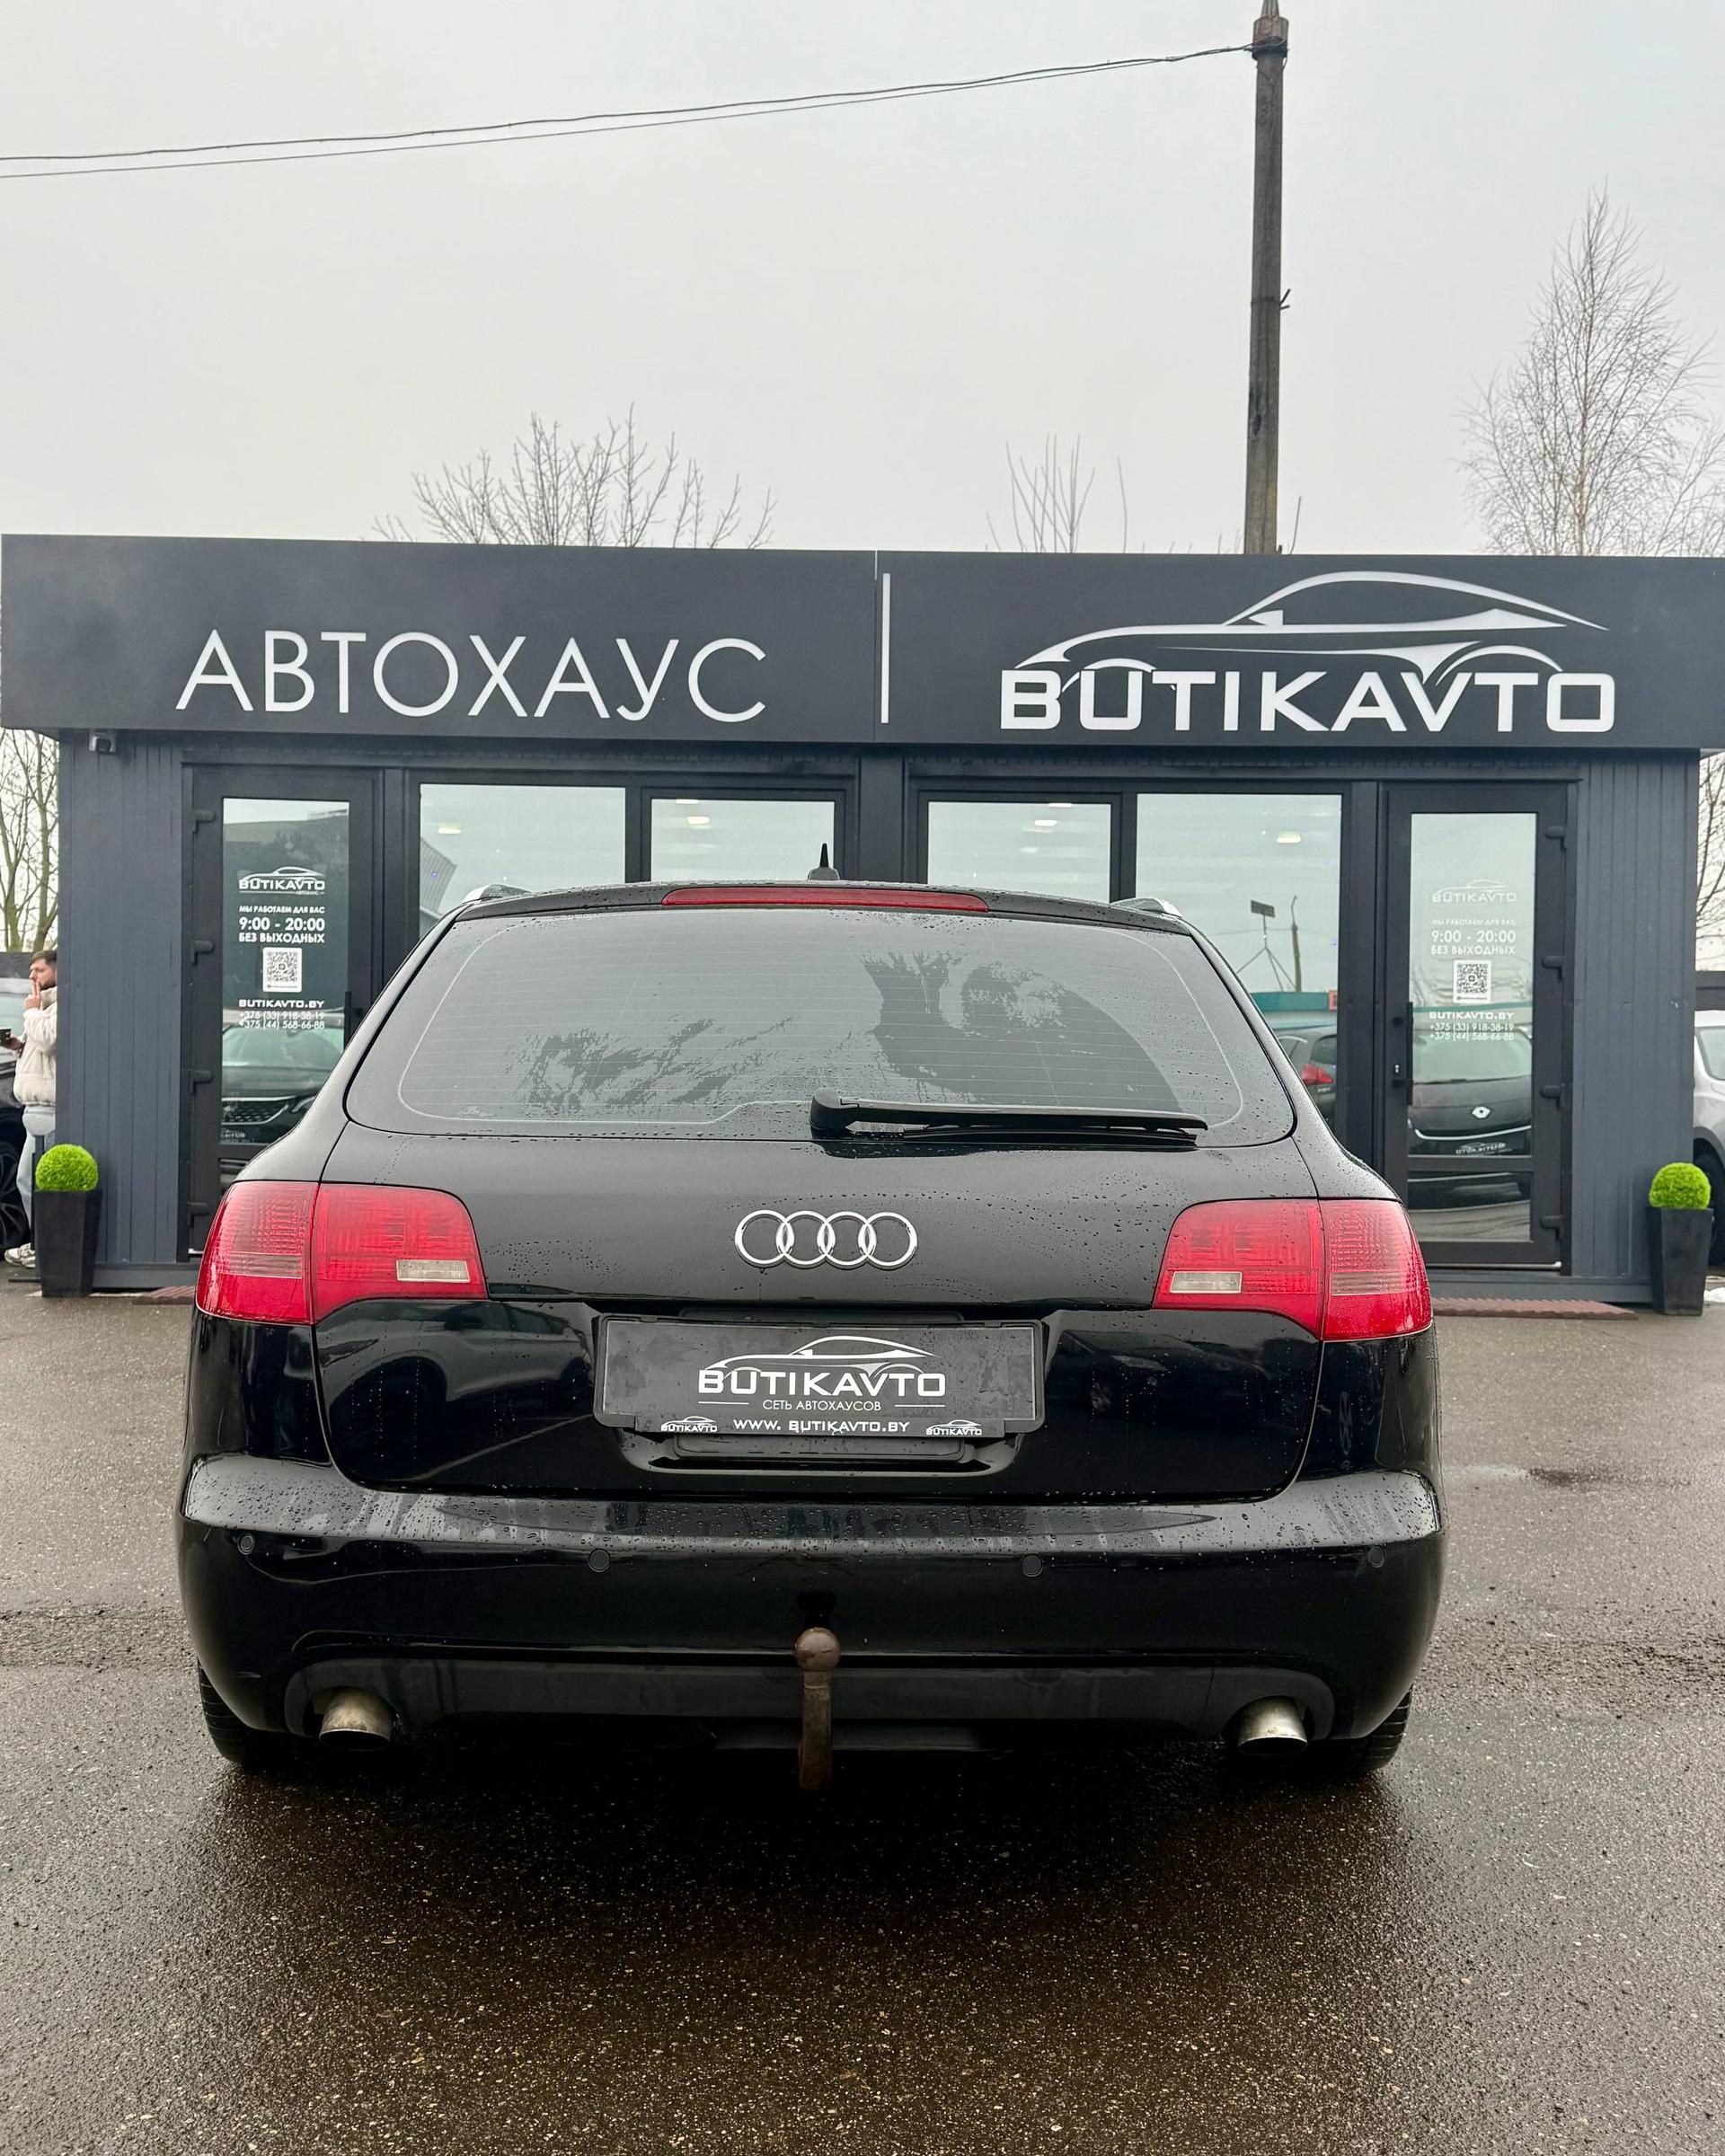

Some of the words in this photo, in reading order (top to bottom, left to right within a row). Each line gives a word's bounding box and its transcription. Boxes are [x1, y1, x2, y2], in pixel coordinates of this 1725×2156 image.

[175, 629, 766, 723] АВТОХАУС
[1000, 668, 1615, 733] BUTIKAVTO
[238, 879, 325, 890] BUTIKAVTO
[1431, 892, 1517, 903] BUTIKAVTO
[253, 906, 292, 914] РАБОТАЕМ
[292, 906, 309, 915] ДЛЯ
[239, 916, 270, 931] 9:00
[285, 917, 325, 932] 20:00
[238, 932, 257, 942] БЕЗ
[259, 932, 325, 944] ВЫХОДНЫХ
[1431, 930, 1462, 943] 9:00
[1476, 930, 1516, 943] 20:00
[1430, 944, 1448, 955] БЕЗ
[1451, 944, 1516, 956] ВЫХОДНЫХ
[238, 999, 325, 1009] BUTIKAVTO.BY
[239, 1011, 261, 1020] +375
[262, 1011, 280, 1021] (33)
[281, 1012, 325, 1021] 918-38-19
[1429, 1012, 1515, 1020] BUTIKAVTO.BY
[238, 1021, 261, 1029] +375
[262, 1020, 280, 1030] (44)
[281, 1021, 325, 1030] 568-66-88
[1430, 1022, 1451, 1031] +375
[1453, 1022, 1470, 1032] (33)
[1471, 1022, 1515, 1032] 918-38-19
[1430, 1032, 1451, 1040] +375
[1453, 1031, 1470, 1042] (44)
[1471, 1032, 1515, 1041] 568-66-88
[698, 1369, 946, 1397] BUTIKAVTO
[762, 1399, 792, 1410] СЕТЬ
[795, 1400, 882, 1411] АВТОХАУСОВ
[660, 1423, 718, 1433] BUTIKAVTO
[733, 1418, 782, 1432] WWW.
[788, 1419, 911, 1435] BUTIKAVTO.BY
[925, 1427, 983, 1436] BUTIKAVTO
